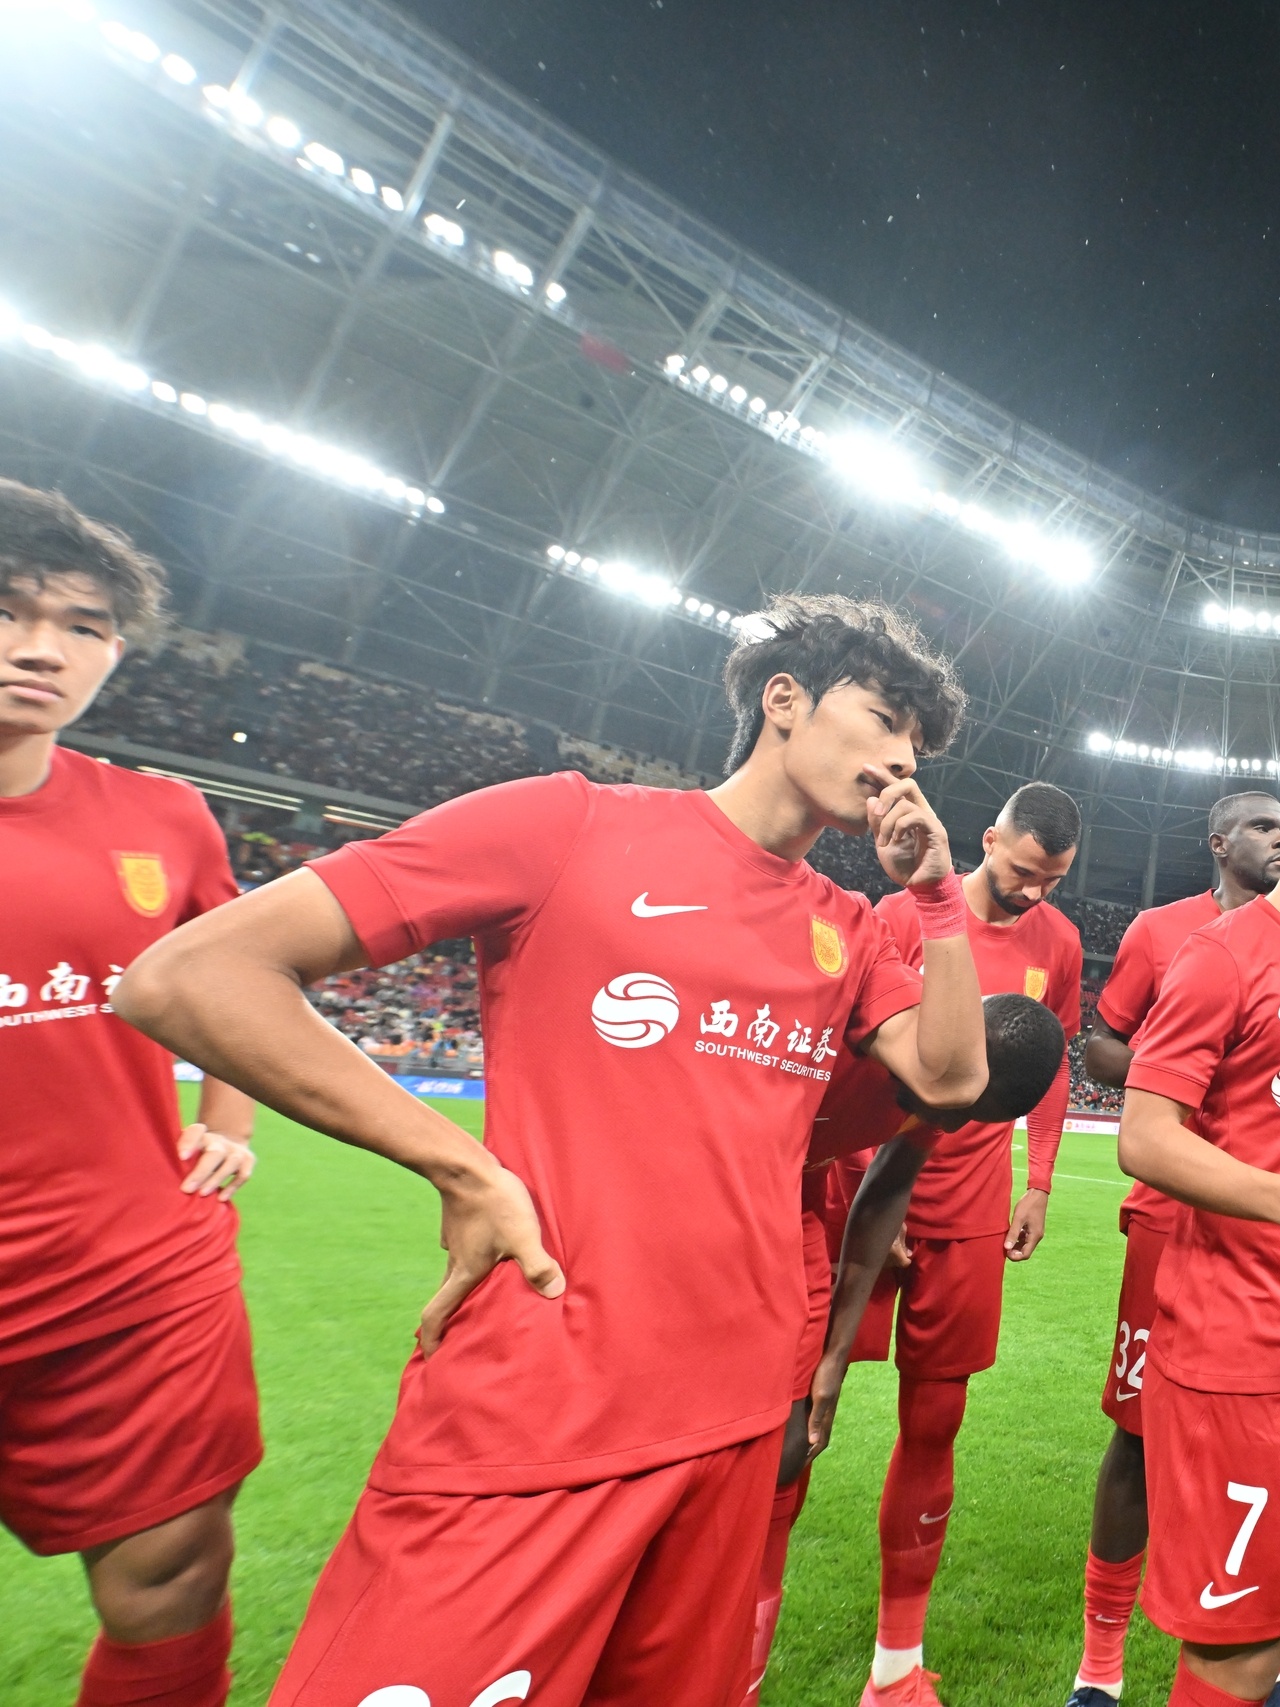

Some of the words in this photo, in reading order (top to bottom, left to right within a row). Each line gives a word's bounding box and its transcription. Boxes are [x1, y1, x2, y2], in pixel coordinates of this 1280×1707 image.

[694, 1040, 780, 1068] SOUTHWEST
[780, 1059, 832, 1082] SECURITIES
[700, 1000, 838, 1063] 西南证券
[1115, 1320, 1150, 1390] 32
[1225, 1481, 1269, 1577] 7
